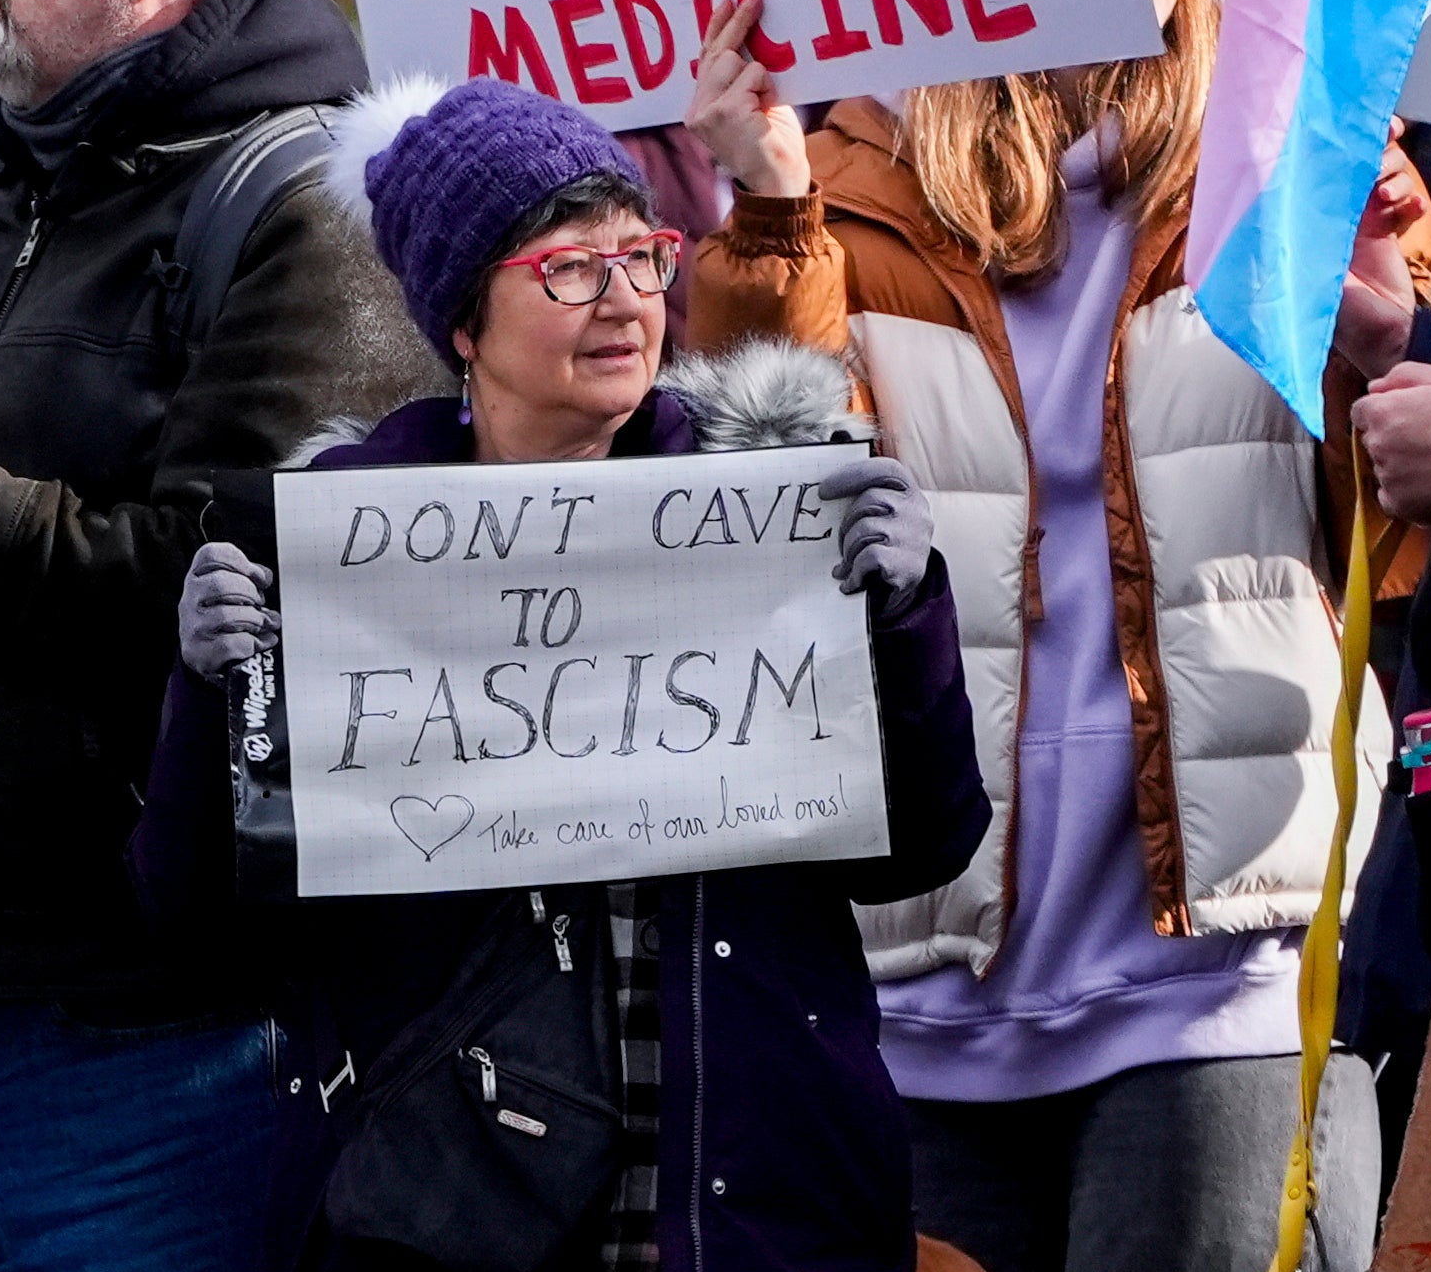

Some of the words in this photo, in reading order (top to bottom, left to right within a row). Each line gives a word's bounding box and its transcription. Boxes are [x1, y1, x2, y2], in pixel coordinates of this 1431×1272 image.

[340, 486, 596, 567] DON'T
[651, 482, 834, 550] CAVE
[500, 586, 583, 648] TO
[327, 640, 833, 773] FASCISM
[477, 811, 539, 853] Take
[556, 823, 614, 845] care
[628, 798, 656, 846] of
[663, 816, 709, 838] our
[715, 775, 784, 829] loved
[794, 774, 848, 820] ones!
